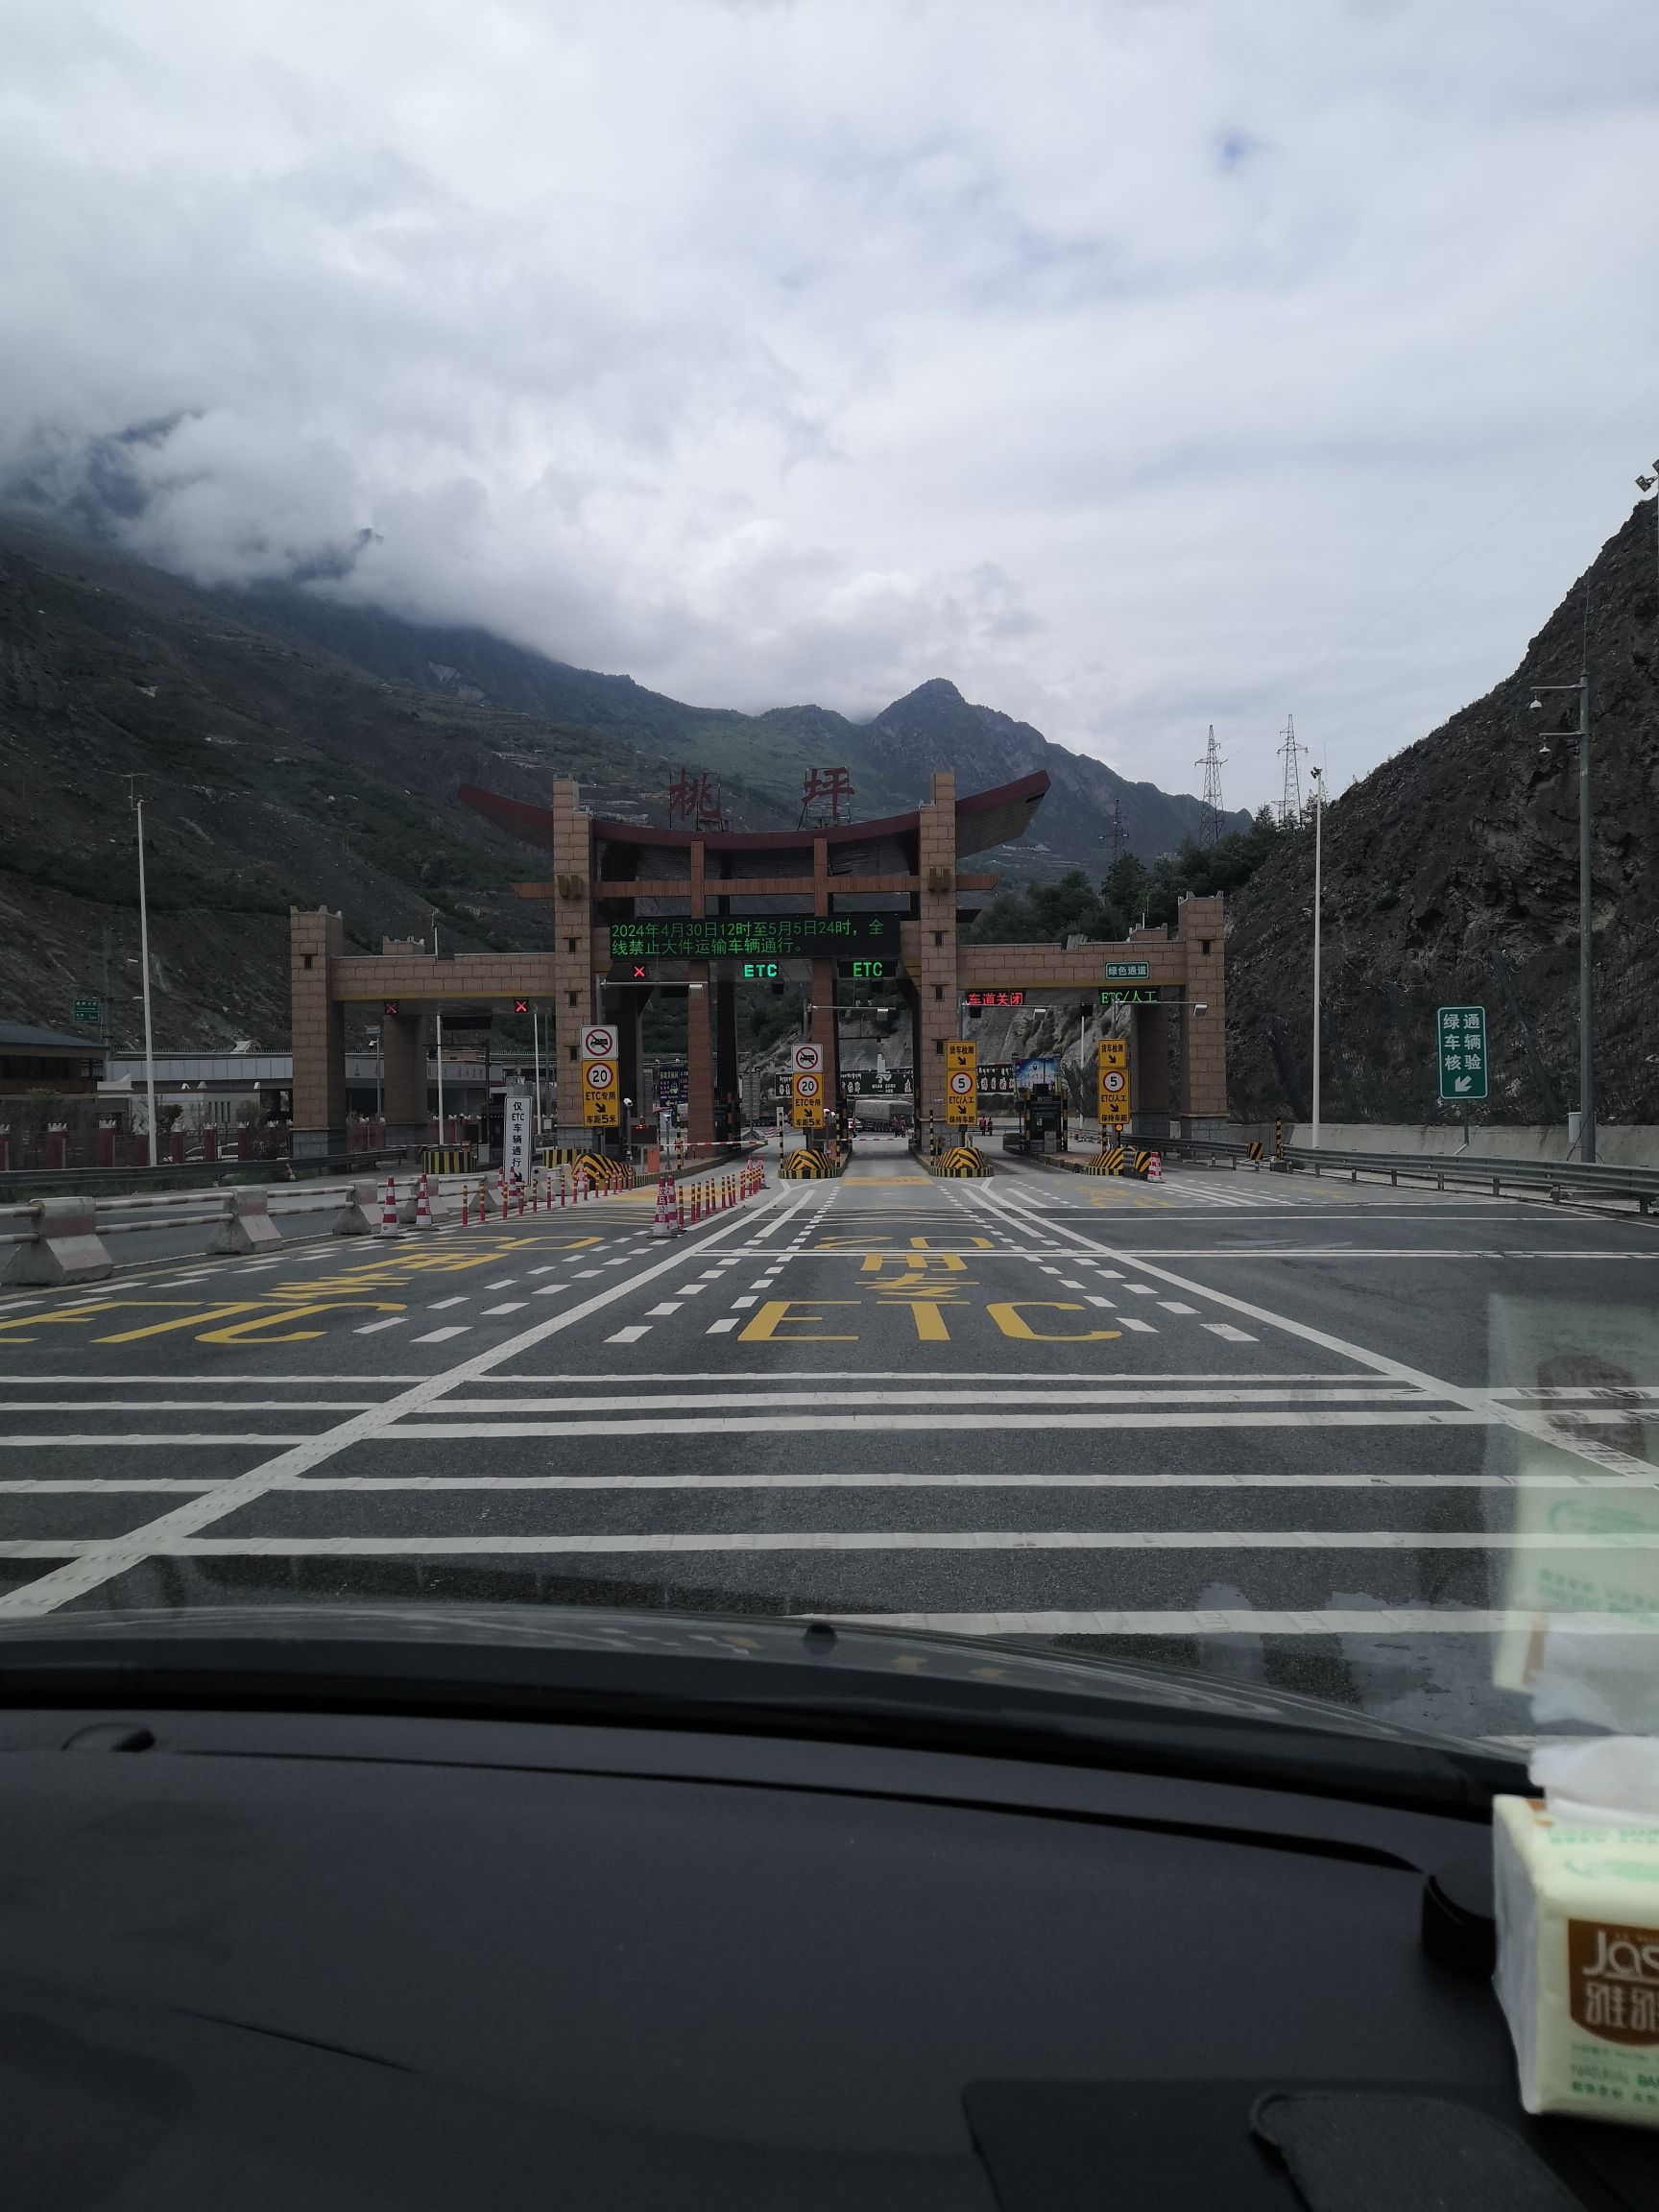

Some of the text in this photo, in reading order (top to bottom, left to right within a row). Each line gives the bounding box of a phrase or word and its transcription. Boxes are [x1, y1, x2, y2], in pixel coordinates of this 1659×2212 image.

[667, 767, 854, 821] 桃坪
[744, 964, 778, 977] ETC
[853, 962, 882, 977] ETC
[1108, 964, 1148, 976] 绿色通道
[968, 992, 1023, 1005] 车道关闭
[1101, 990, 1157, 1004] ETC/人工
[1443, 1013, 1480, 1030] 绿通
[1444, 1033, 1481, 1051] 车辆
[1444, 1053, 1482, 1071] 核验
[592, 1070, 608, 1083] 20
[958, 1077, 966, 1089] 5
[1109, 1076, 1118, 1087] 5
[802, 1081, 814, 1092] 20
[586, 1092, 615, 1101] ETC专用
[1101, 1094, 1127, 1102] ETC/人工
[586, 1115, 616, 1124] 车距5米
[814, 1236, 997, 1250] 20
[736, 1300, 1122, 1342] ETC
